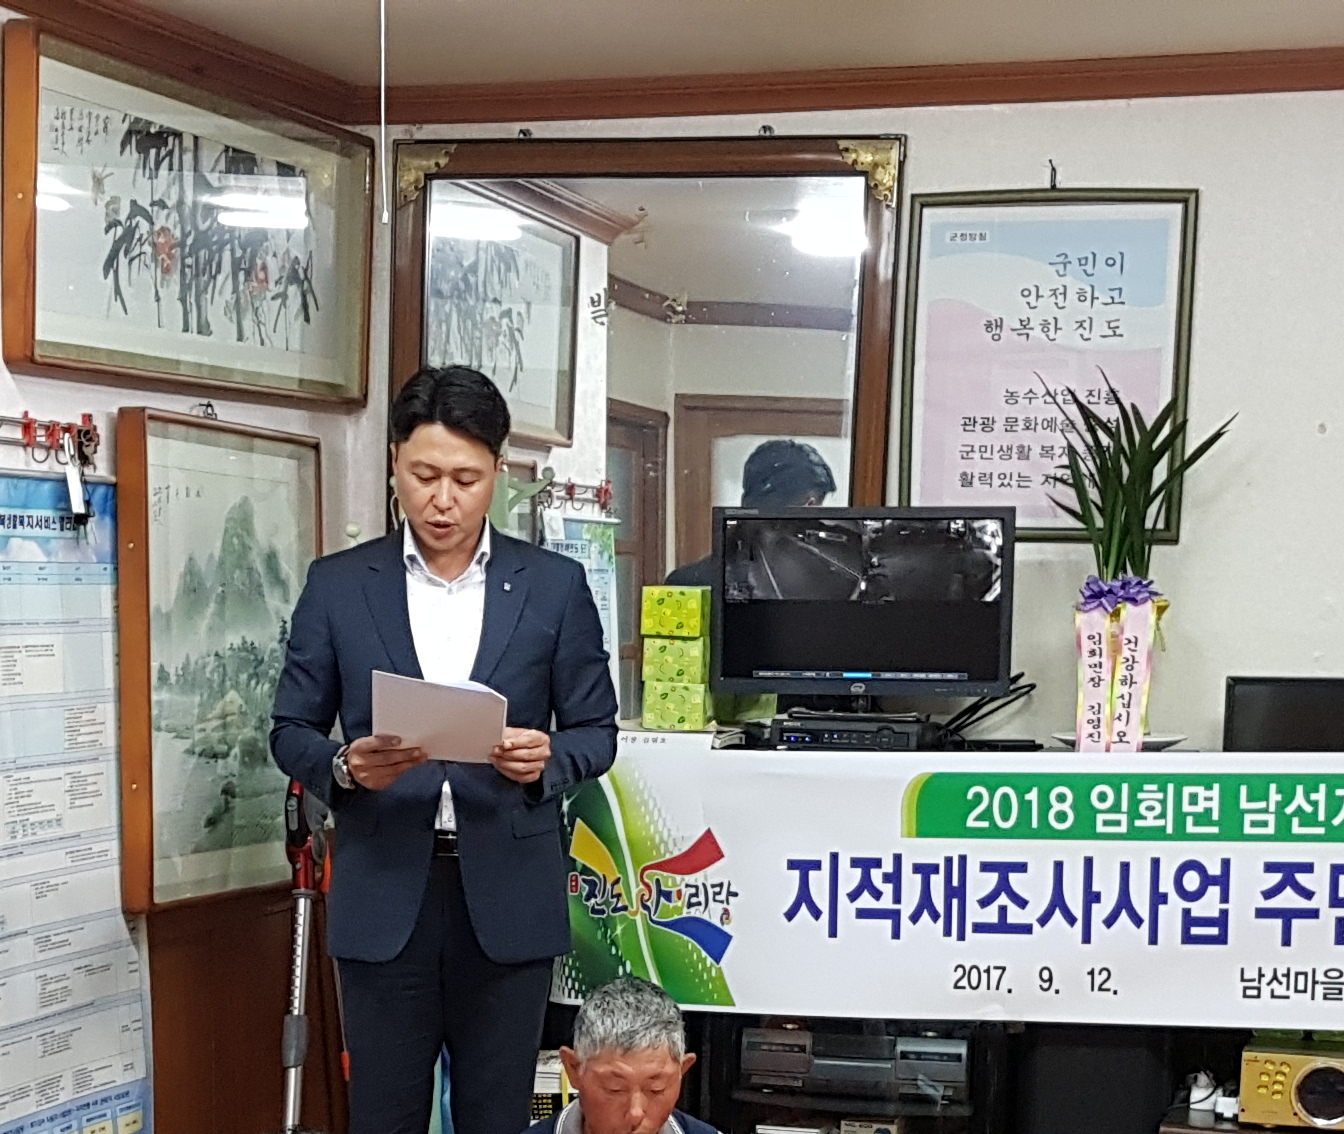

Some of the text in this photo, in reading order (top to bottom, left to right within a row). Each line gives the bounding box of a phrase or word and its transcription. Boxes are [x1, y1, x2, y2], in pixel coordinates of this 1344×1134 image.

[1048, 251, 1125, 278] 군민이
[1021, 284, 1126, 310] 안전하고
[983, 316, 1124, 342] 행복한 진도
[1003, 388, 1076, 406] 농수산업
[960, 416, 997, 433] 관광
[959, 443, 1032, 461] 군민생활
[959, 470, 1032, 488] 활력있는
[1111, 635, 1138, 744] 건강하십시오
[966, 786, 1074, 829] 2018
[1090, 784, 1221, 833] 임회면
[783, 852, 1231, 946] 지적재조사사업
[953, 964, 1118, 995] 2017. 9. 12.
